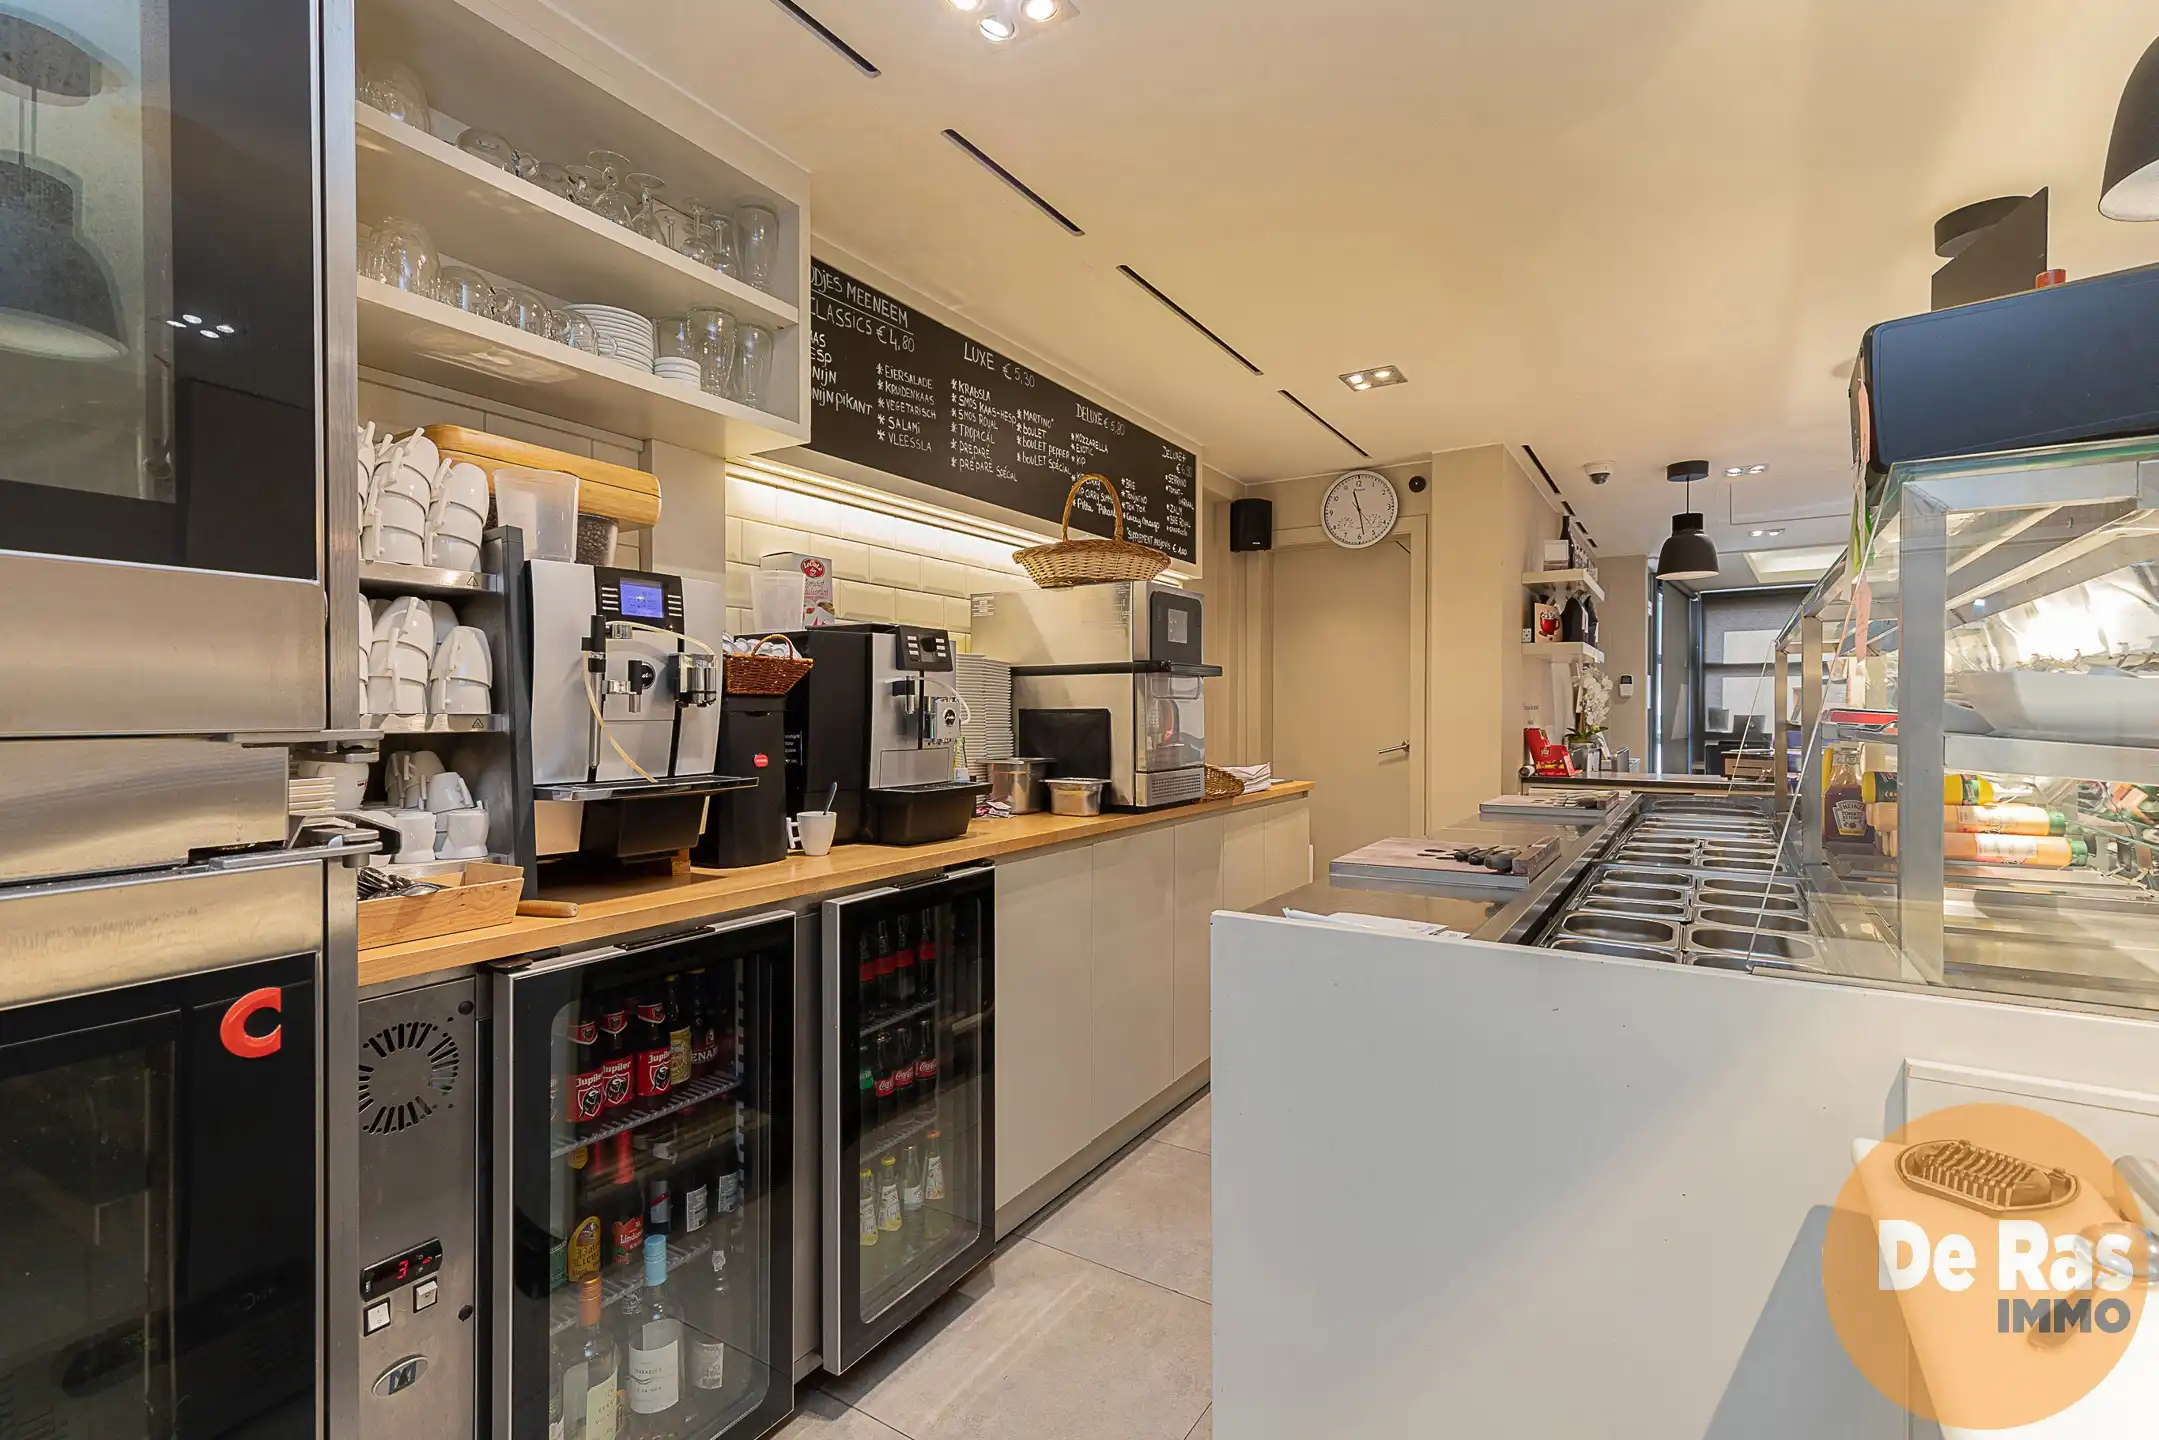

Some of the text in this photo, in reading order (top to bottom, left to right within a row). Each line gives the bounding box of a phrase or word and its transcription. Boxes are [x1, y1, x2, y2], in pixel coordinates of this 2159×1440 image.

[846, 281, 908, 329] MEENEEM
[876, 325, 887, 344] €
[890, 329, 915, 352] 4,80
[964, 341, 1036, 388] LUXE € 5,30
[1075, 403, 1103, 426] DELUXE
[396, 1259, 409, 1280] 3
